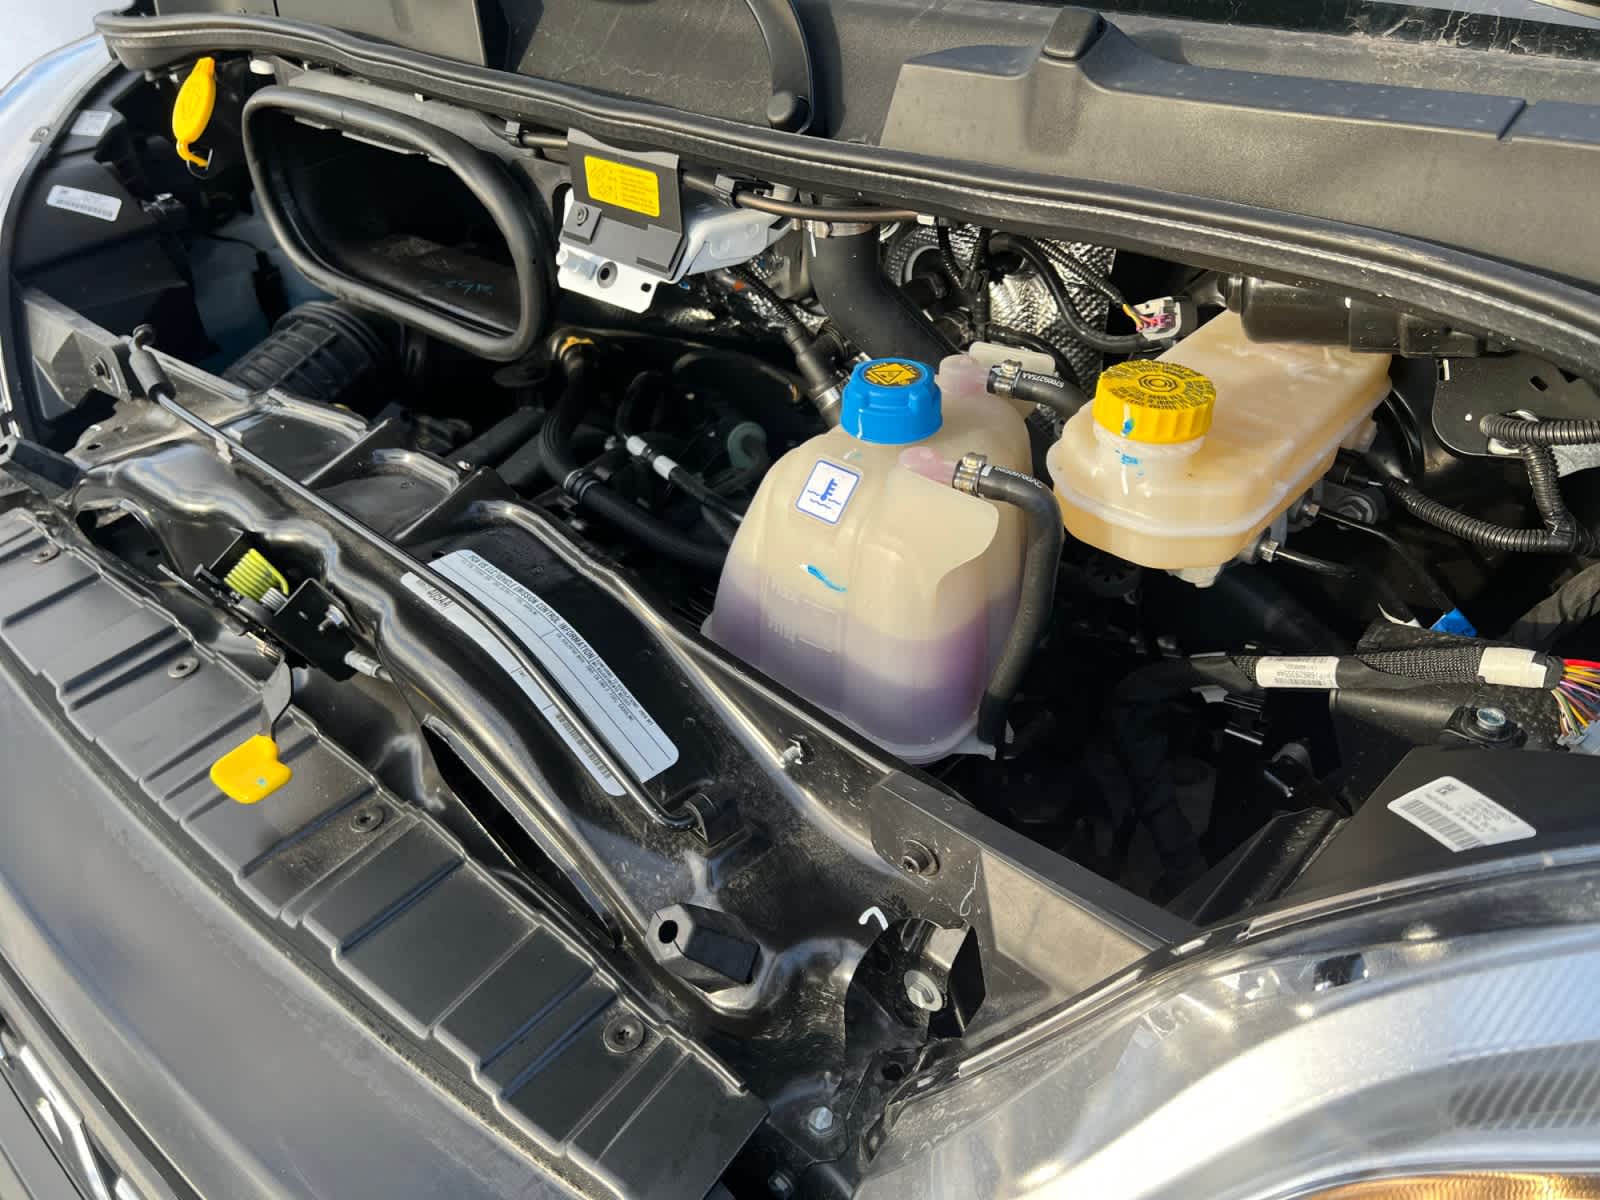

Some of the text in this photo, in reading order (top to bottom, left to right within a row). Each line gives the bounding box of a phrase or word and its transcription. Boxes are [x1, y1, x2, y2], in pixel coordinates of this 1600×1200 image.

[514, 583, 539, 605] EMISSION
[535, 602, 561, 624] CONTROL
[559, 622, 598, 660] INFORMATION
